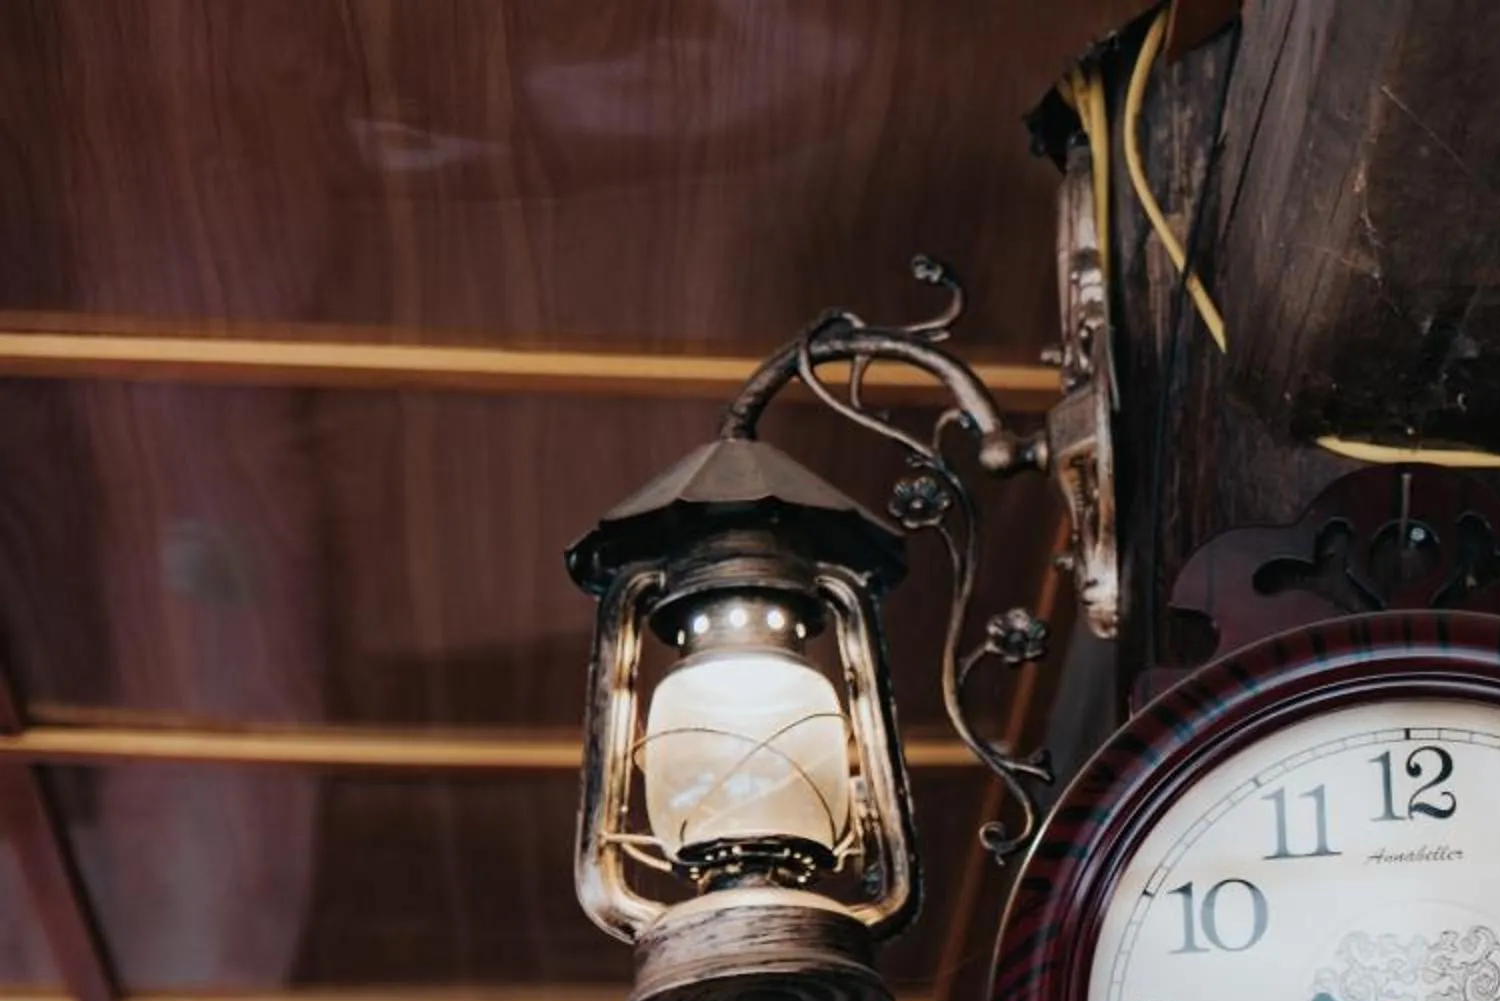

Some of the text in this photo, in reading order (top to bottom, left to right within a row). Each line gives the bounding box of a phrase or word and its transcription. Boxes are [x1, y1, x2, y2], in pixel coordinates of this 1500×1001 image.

[1261, 784, 1342, 861] 11
[1369, 745, 1457, 823] 12
[1166, 878, 1270, 956] 10
